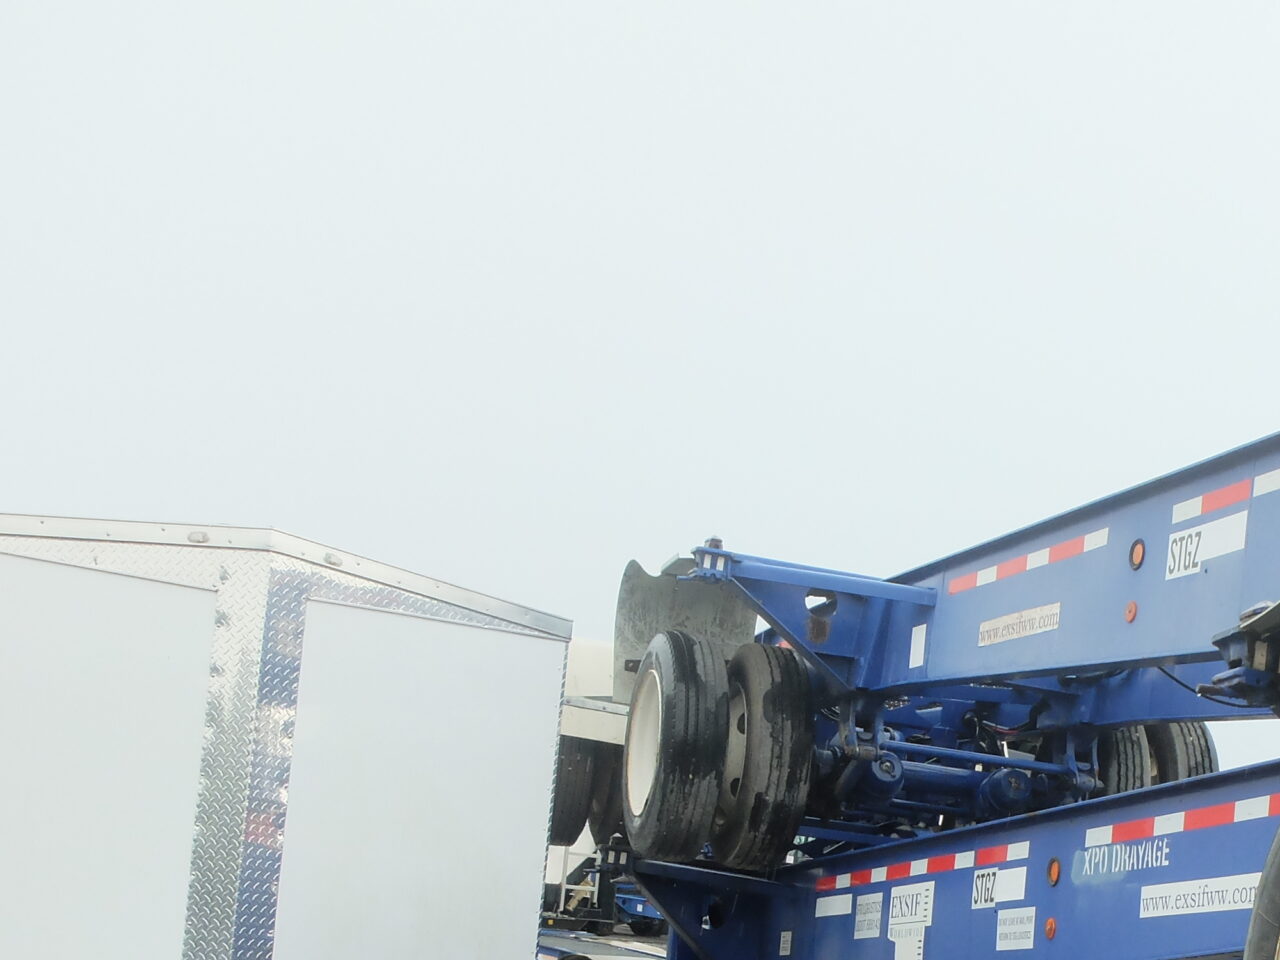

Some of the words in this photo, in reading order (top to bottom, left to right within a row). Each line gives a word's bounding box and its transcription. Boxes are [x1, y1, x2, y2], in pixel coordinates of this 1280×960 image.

[1168, 530, 1202, 575] STGZ
[1082, 845, 1108, 876] XPO
[1112, 838, 1171, 873] DRAYAGE
[890, 892, 922, 919] EXSIF
[973, 871, 997, 905] STGZ
